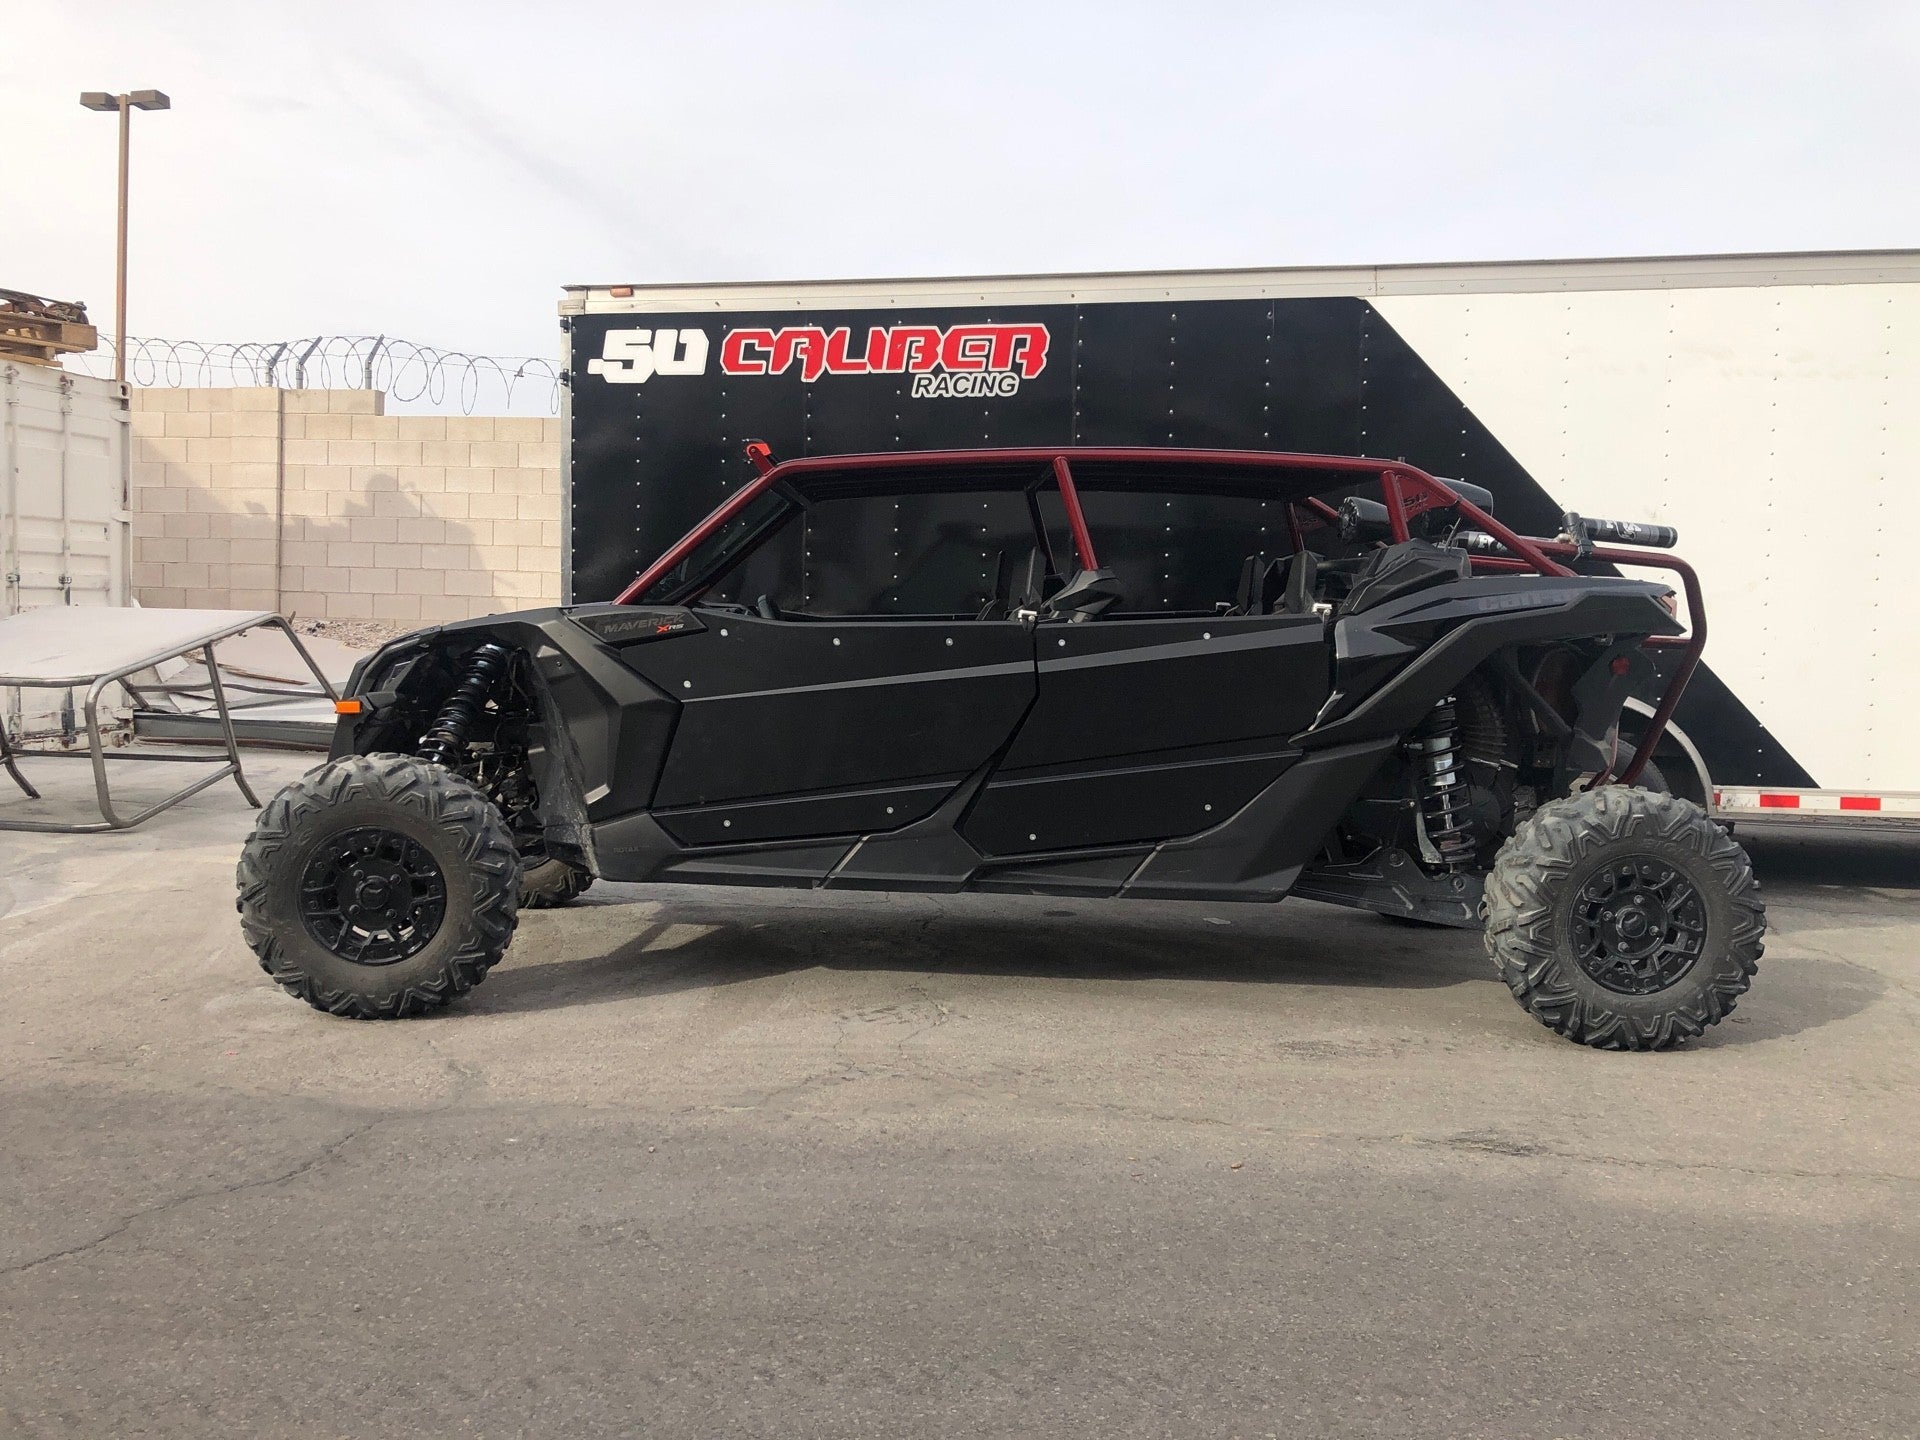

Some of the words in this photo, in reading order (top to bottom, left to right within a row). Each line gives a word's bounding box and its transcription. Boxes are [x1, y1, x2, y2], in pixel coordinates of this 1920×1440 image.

[720, 324, 1050, 383] CALIBER
[912, 373, 1018, 397] RACING
[604, 613, 685, 634] MAVERICK
